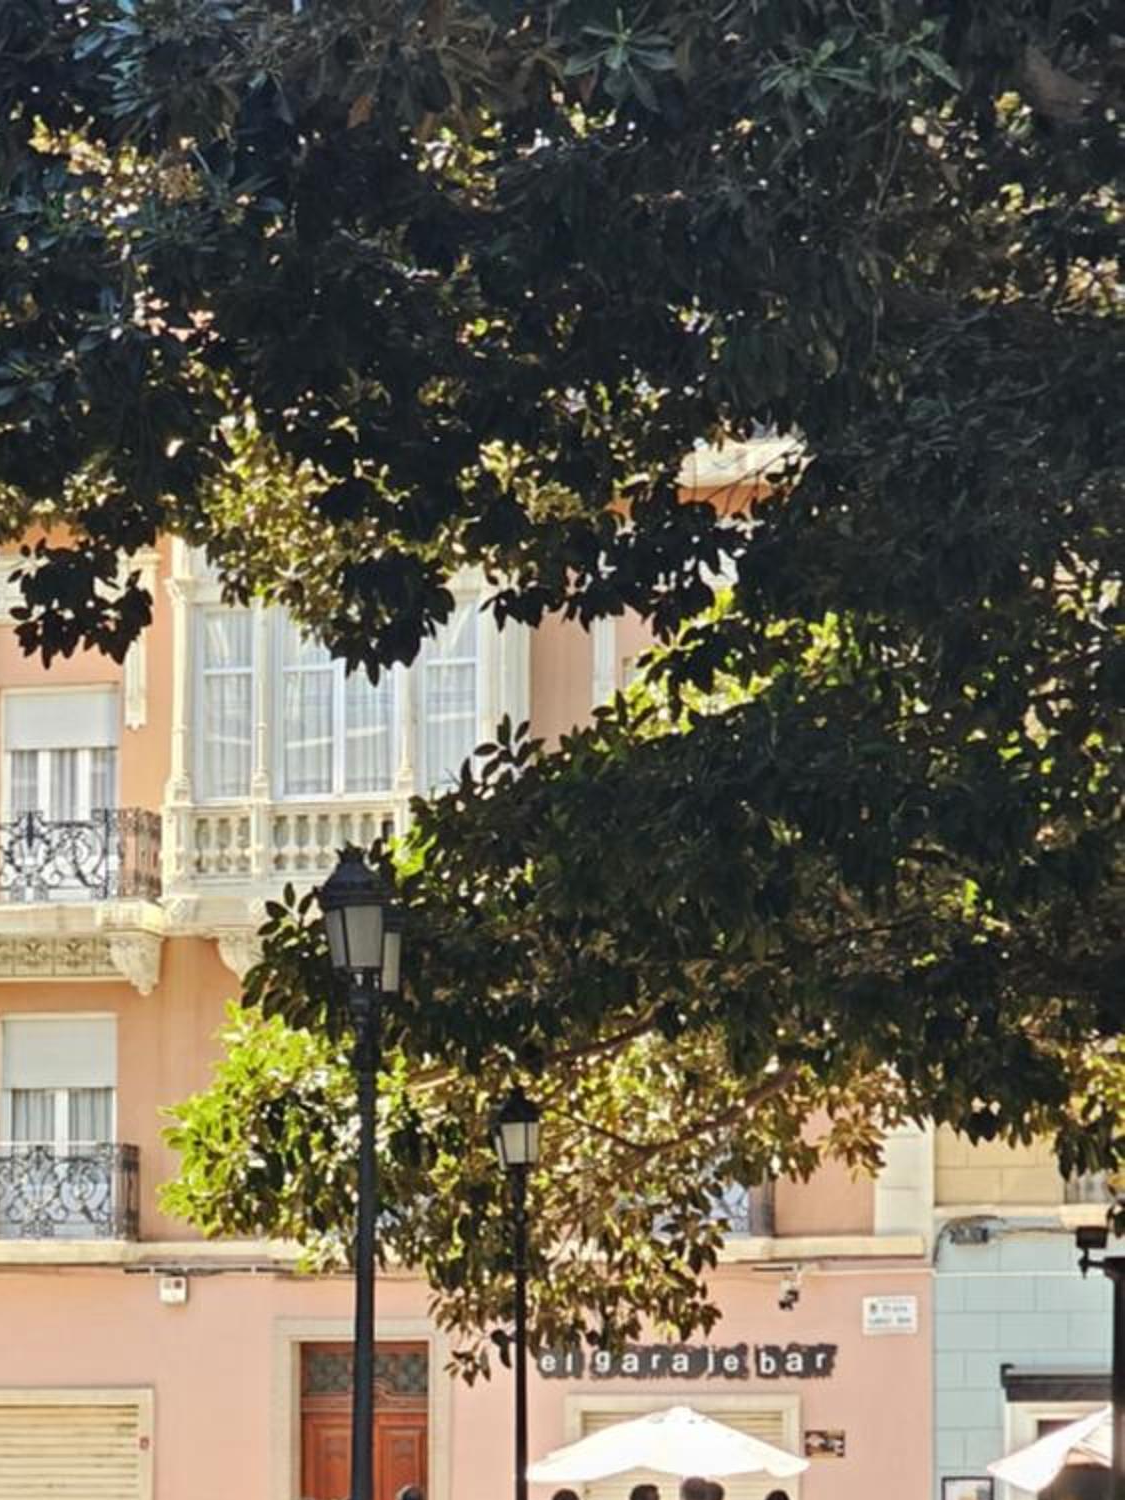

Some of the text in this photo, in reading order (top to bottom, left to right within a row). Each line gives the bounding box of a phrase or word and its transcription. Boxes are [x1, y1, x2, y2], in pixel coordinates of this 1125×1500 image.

[540, 1350, 828, 1373] el garaje bar
